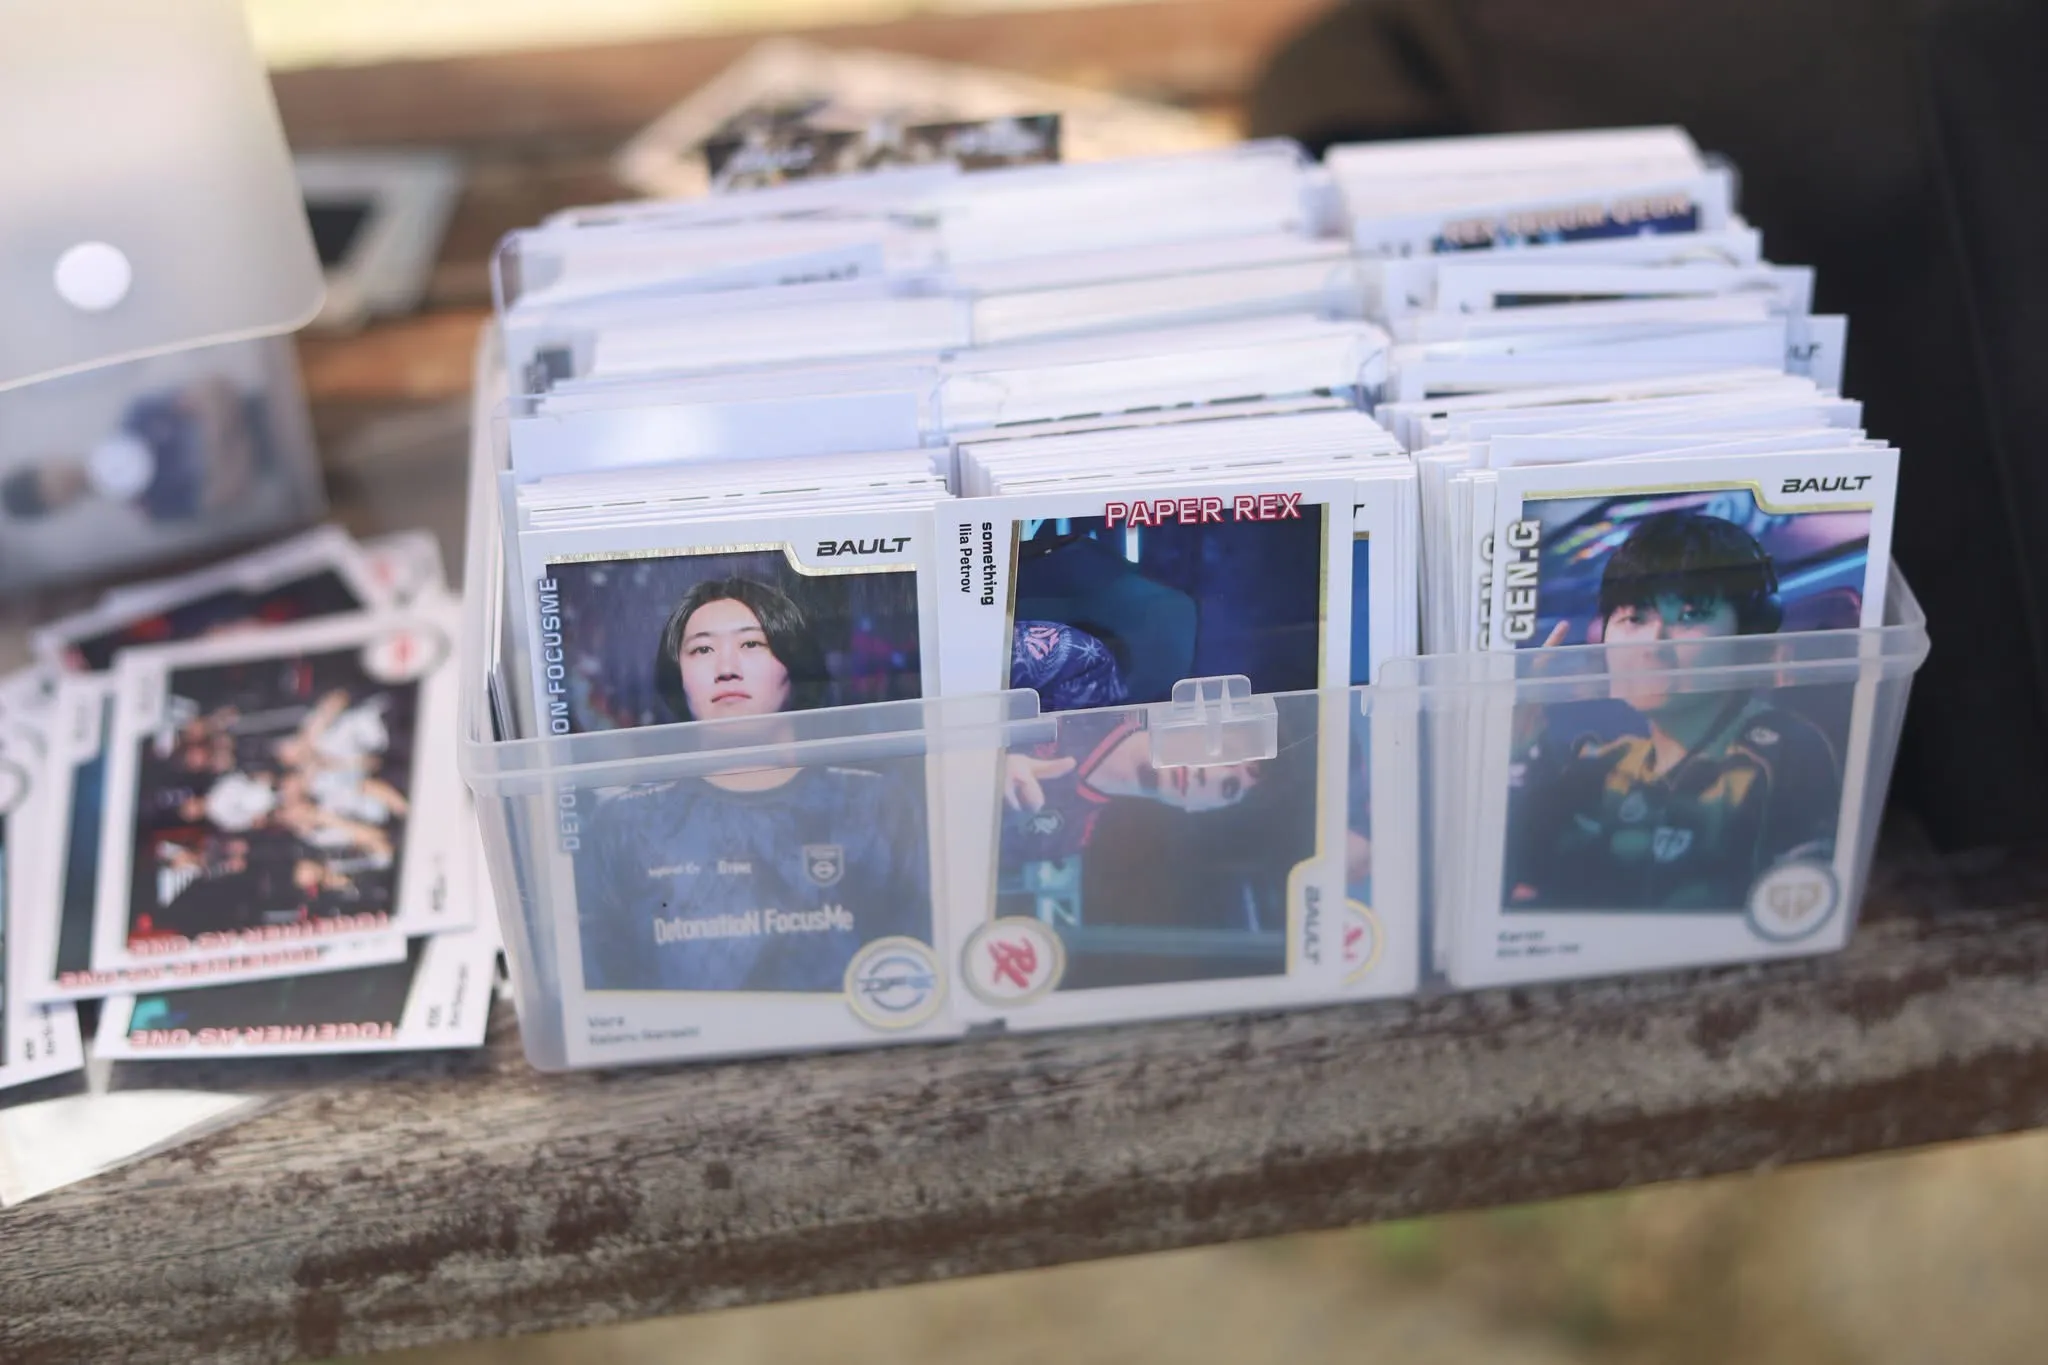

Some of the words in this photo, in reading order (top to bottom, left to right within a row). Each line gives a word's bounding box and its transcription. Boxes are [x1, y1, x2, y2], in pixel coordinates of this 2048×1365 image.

[1781, 475, 1872, 494] BAULT
[1105, 496, 1224, 529] PAPER
[1233, 493, 1302, 522] REX
[816, 536, 912, 557] BAULT
[959, 523, 972, 545] Ilia
[960, 548, 973, 594] Petrov
[981, 522, 997, 606] something
[1502, 518, 1541, 643] GEN.G
[537, 576, 567, 695] FOCUSME
[764, 903, 854, 934] FocusMe
[130, 1027, 191, 1050] ONE
[197, 1027, 240, 1048] AS
[245, 1020, 397, 1048] TOGETHER
